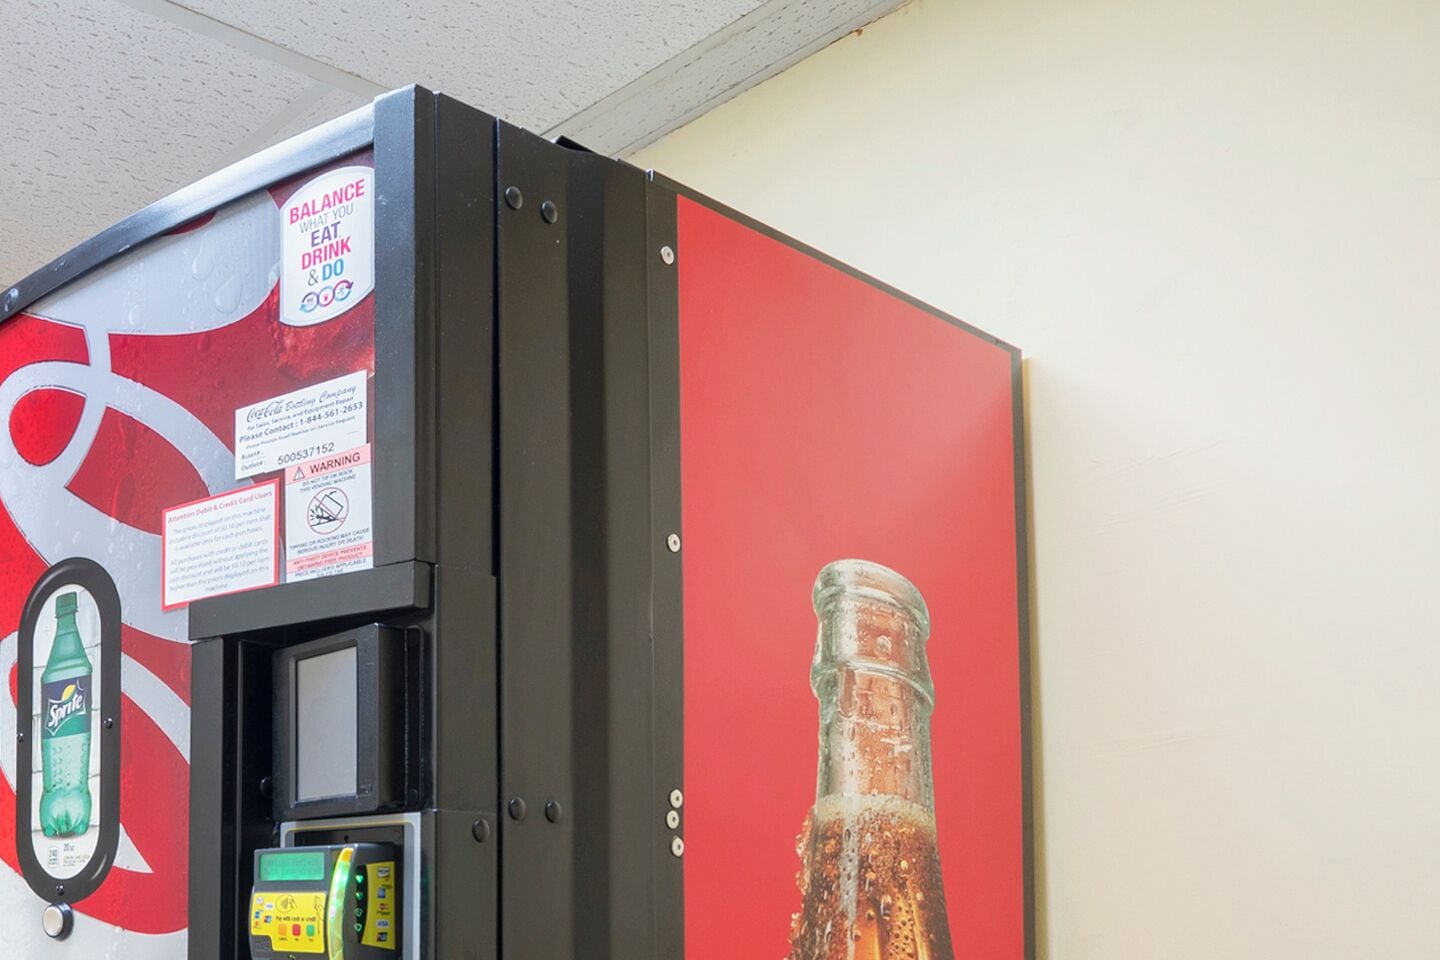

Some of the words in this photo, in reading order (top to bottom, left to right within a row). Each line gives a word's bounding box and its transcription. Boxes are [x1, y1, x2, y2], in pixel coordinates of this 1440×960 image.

[289, 179, 365, 224] BALANCE
[299, 214, 328, 234] WHAT
[332, 203, 354, 222] YOU
[310, 221, 341, 248] EAT
[301, 237, 352, 271] DRINK
[307, 270, 319, 286] &
[322, 259, 344, 281] DO
[319, 385, 357, 403] Company
[239, 431, 262, 444] Please
[300, 401, 363, 426] 1-844-561-2653
[278, 442, 335, 466] 500537152
[310, 452, 360, 474] WARNING
[48, 693, 83, 728] Sprite
